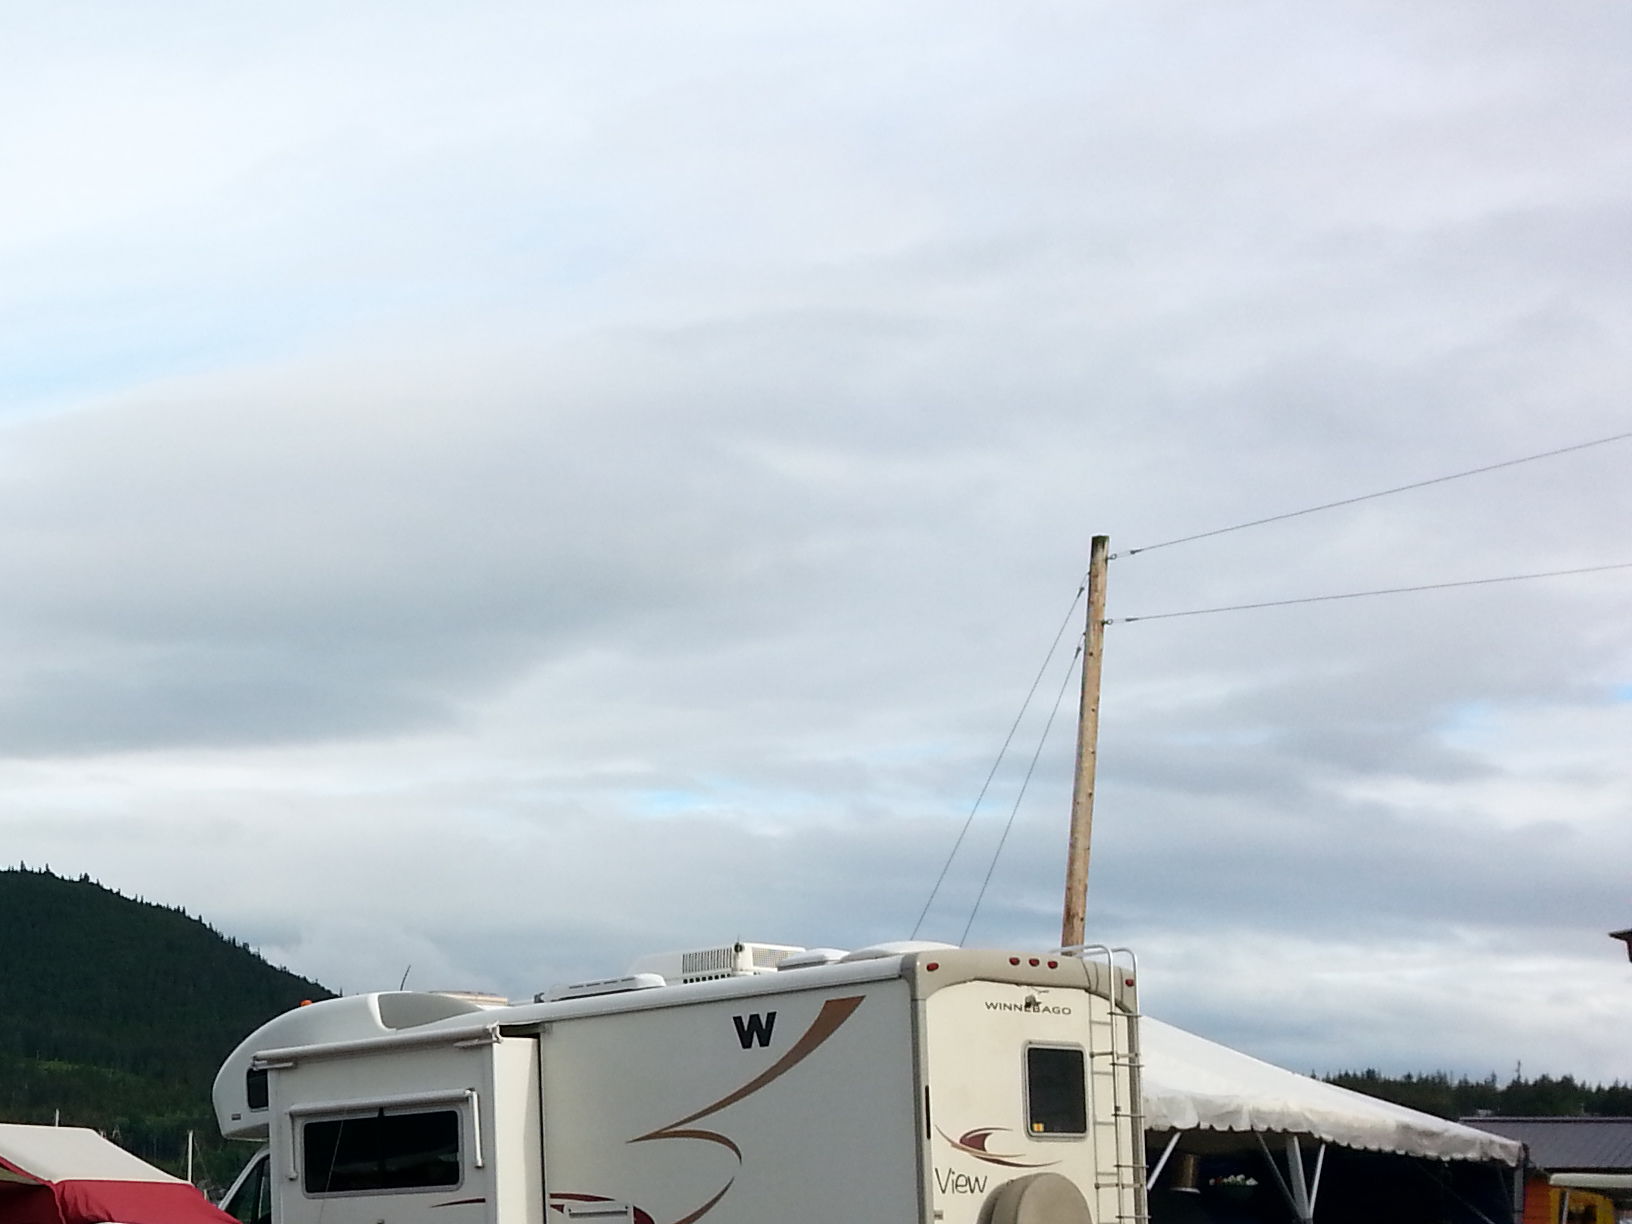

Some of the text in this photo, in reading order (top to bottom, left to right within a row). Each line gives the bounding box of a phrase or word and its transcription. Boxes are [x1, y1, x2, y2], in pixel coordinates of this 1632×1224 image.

[985, 1001, 1072, 1015] WINNEBAGO
[732, 1011, 777, 1049] W
[934, 1167, 988, 1194] View
